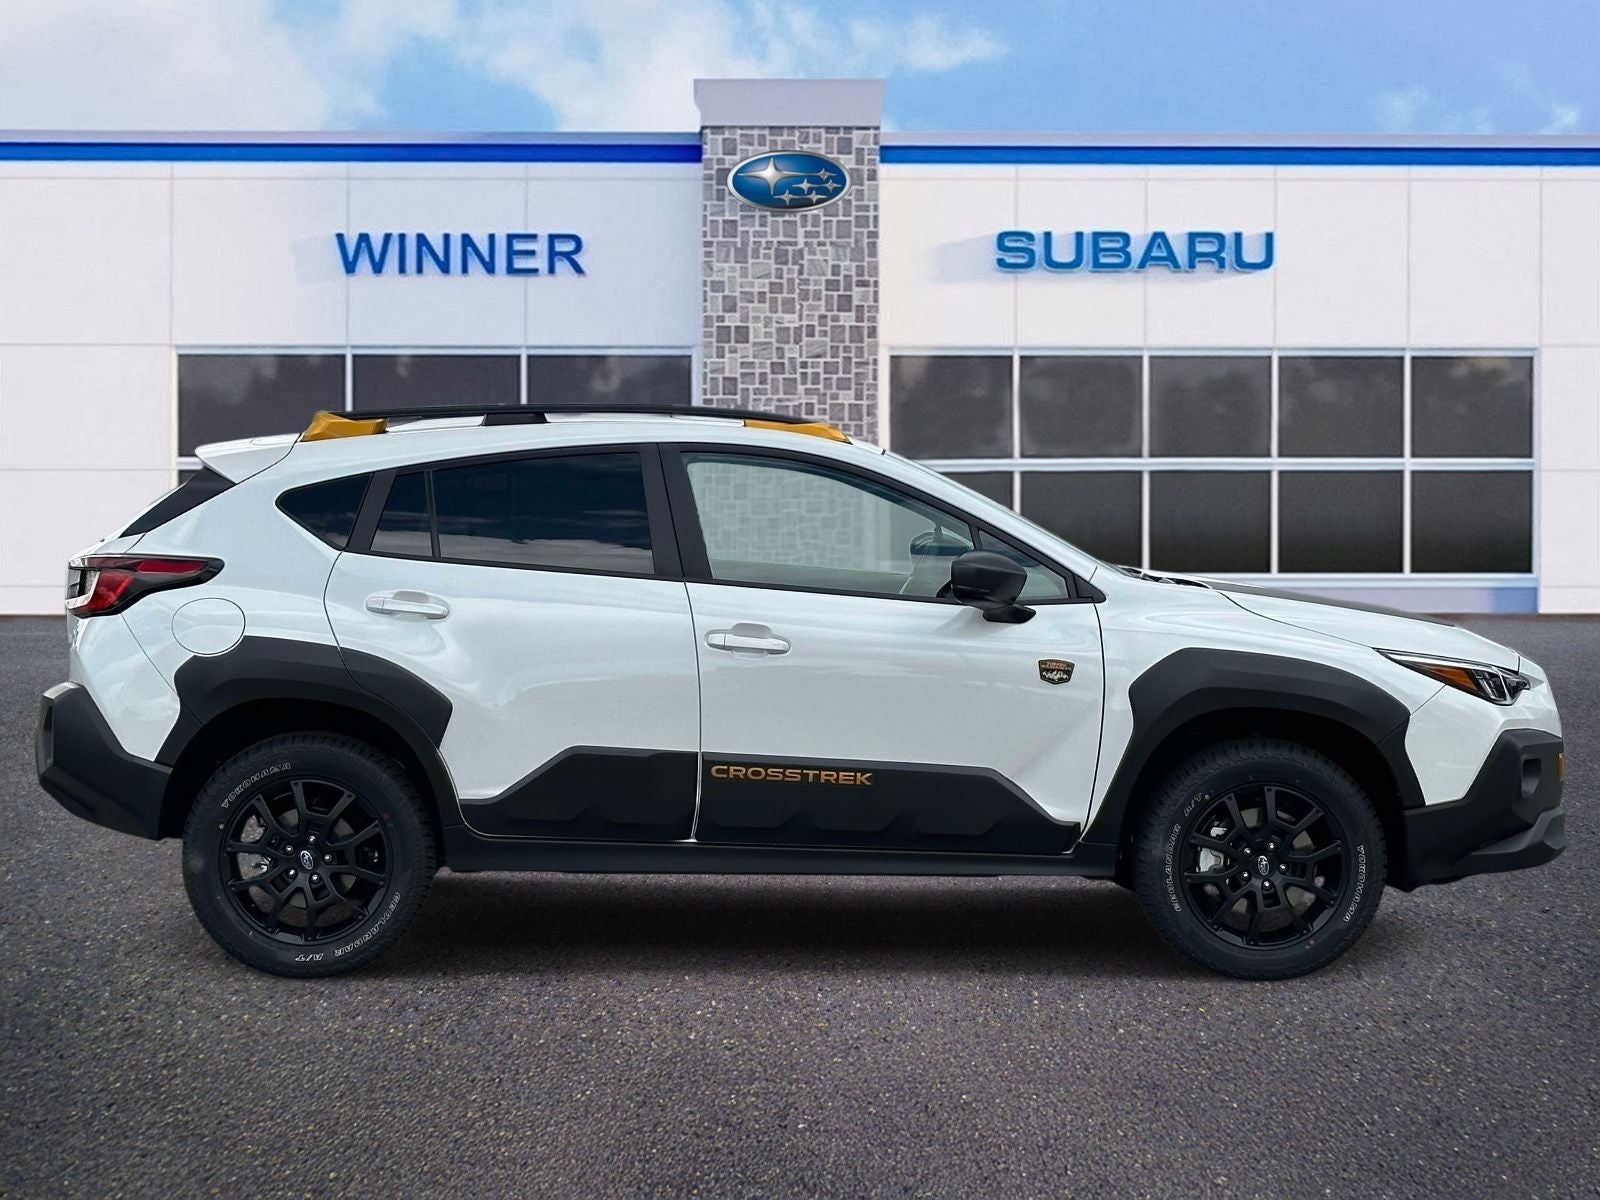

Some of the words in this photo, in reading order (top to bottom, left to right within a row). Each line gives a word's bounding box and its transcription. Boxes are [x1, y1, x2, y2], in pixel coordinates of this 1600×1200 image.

[335, 232, 588, 275] WINNER
[995, 230, 1275, 271] SUBARU
[221, 761, 292, 809] YOKOHAMA
[710, 765, 873, 786] CROSSTREK
[1342, 844, 1365, 923] YOKOHAMA
[334, 891, 401, 957] GEOLANDAR
